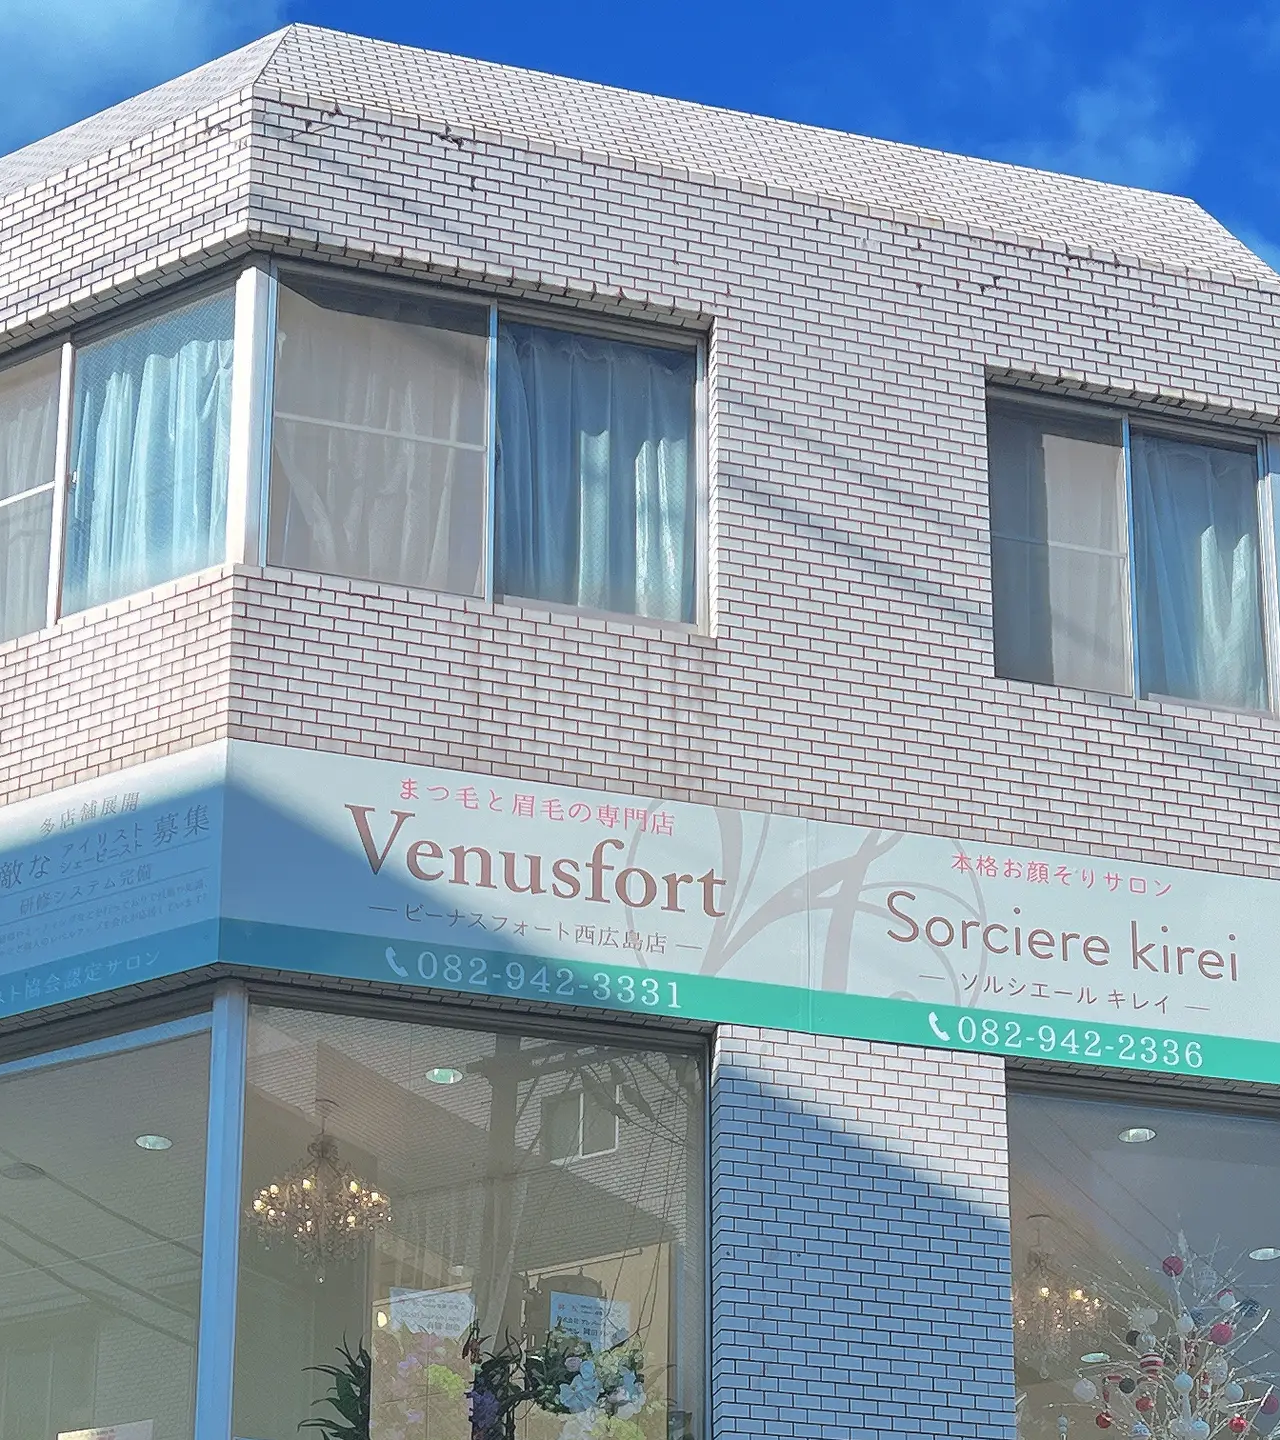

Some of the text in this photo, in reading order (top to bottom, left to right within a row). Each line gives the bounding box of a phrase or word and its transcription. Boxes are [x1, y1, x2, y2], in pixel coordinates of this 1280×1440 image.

[39, 791, 140, 836] 多店舗展開
[61, 821, 145, 859] アイリスト
[152, 804, 211, 847] 募集
[399, 777, 675, 836] まつ毛と眉毛の専門店
[18, 863, 154, 914] 研修システム完備
[345, 803, 727, 919] Venusfort
[950, 853, 1173, 898] 本格お顔そりサロン
[404, 903, 669, 955] ビーナスフォート西広島店
[885, 889, 1239, 983] Sorciere kirei
[417, 950, 683, 1010] 082-942-3331
[960, 972, 1170, 1016] ソルシエール キレイ
[956, 1014, 1203, 1070] 082-942-2336
